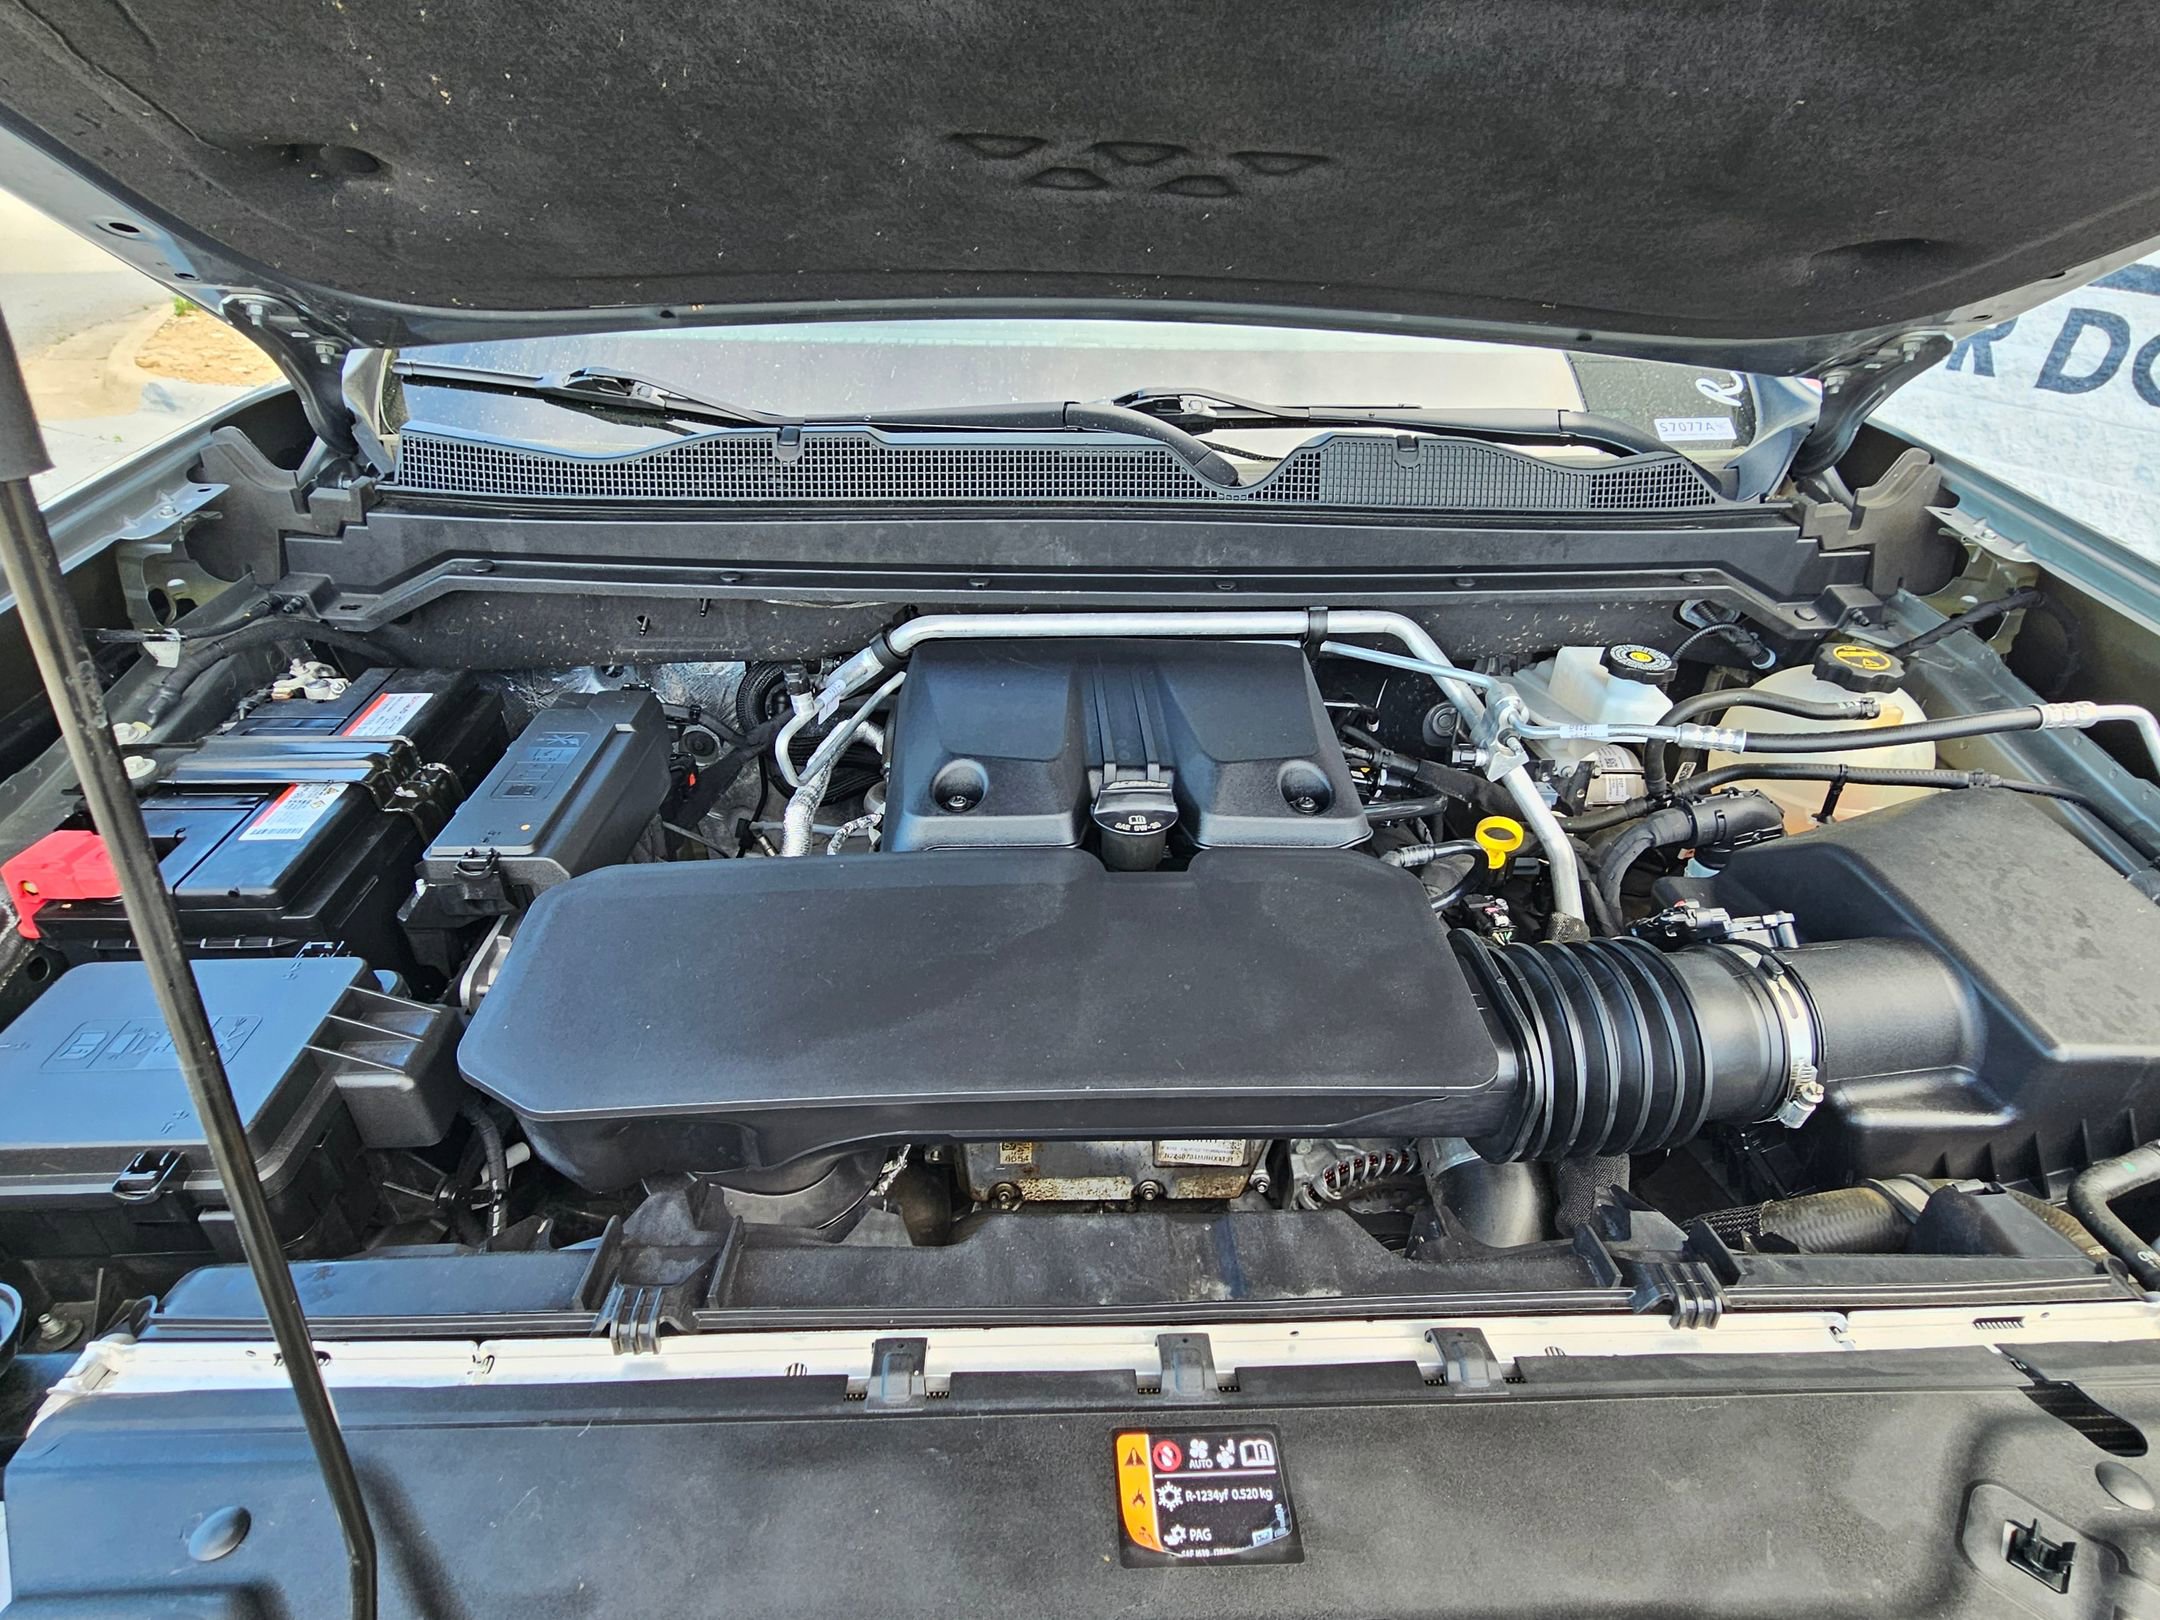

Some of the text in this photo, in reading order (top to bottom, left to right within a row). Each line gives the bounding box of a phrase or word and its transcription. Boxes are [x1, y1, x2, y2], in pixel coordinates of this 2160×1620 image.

[2034, 307, 2160, 408] D
[1189, 1458, 1213, 1470] AUTO
[1185, 1486, 1274, 1503] R-1234yf 0.520 kg
[1189, 1528, 1212, 1542] PAG
